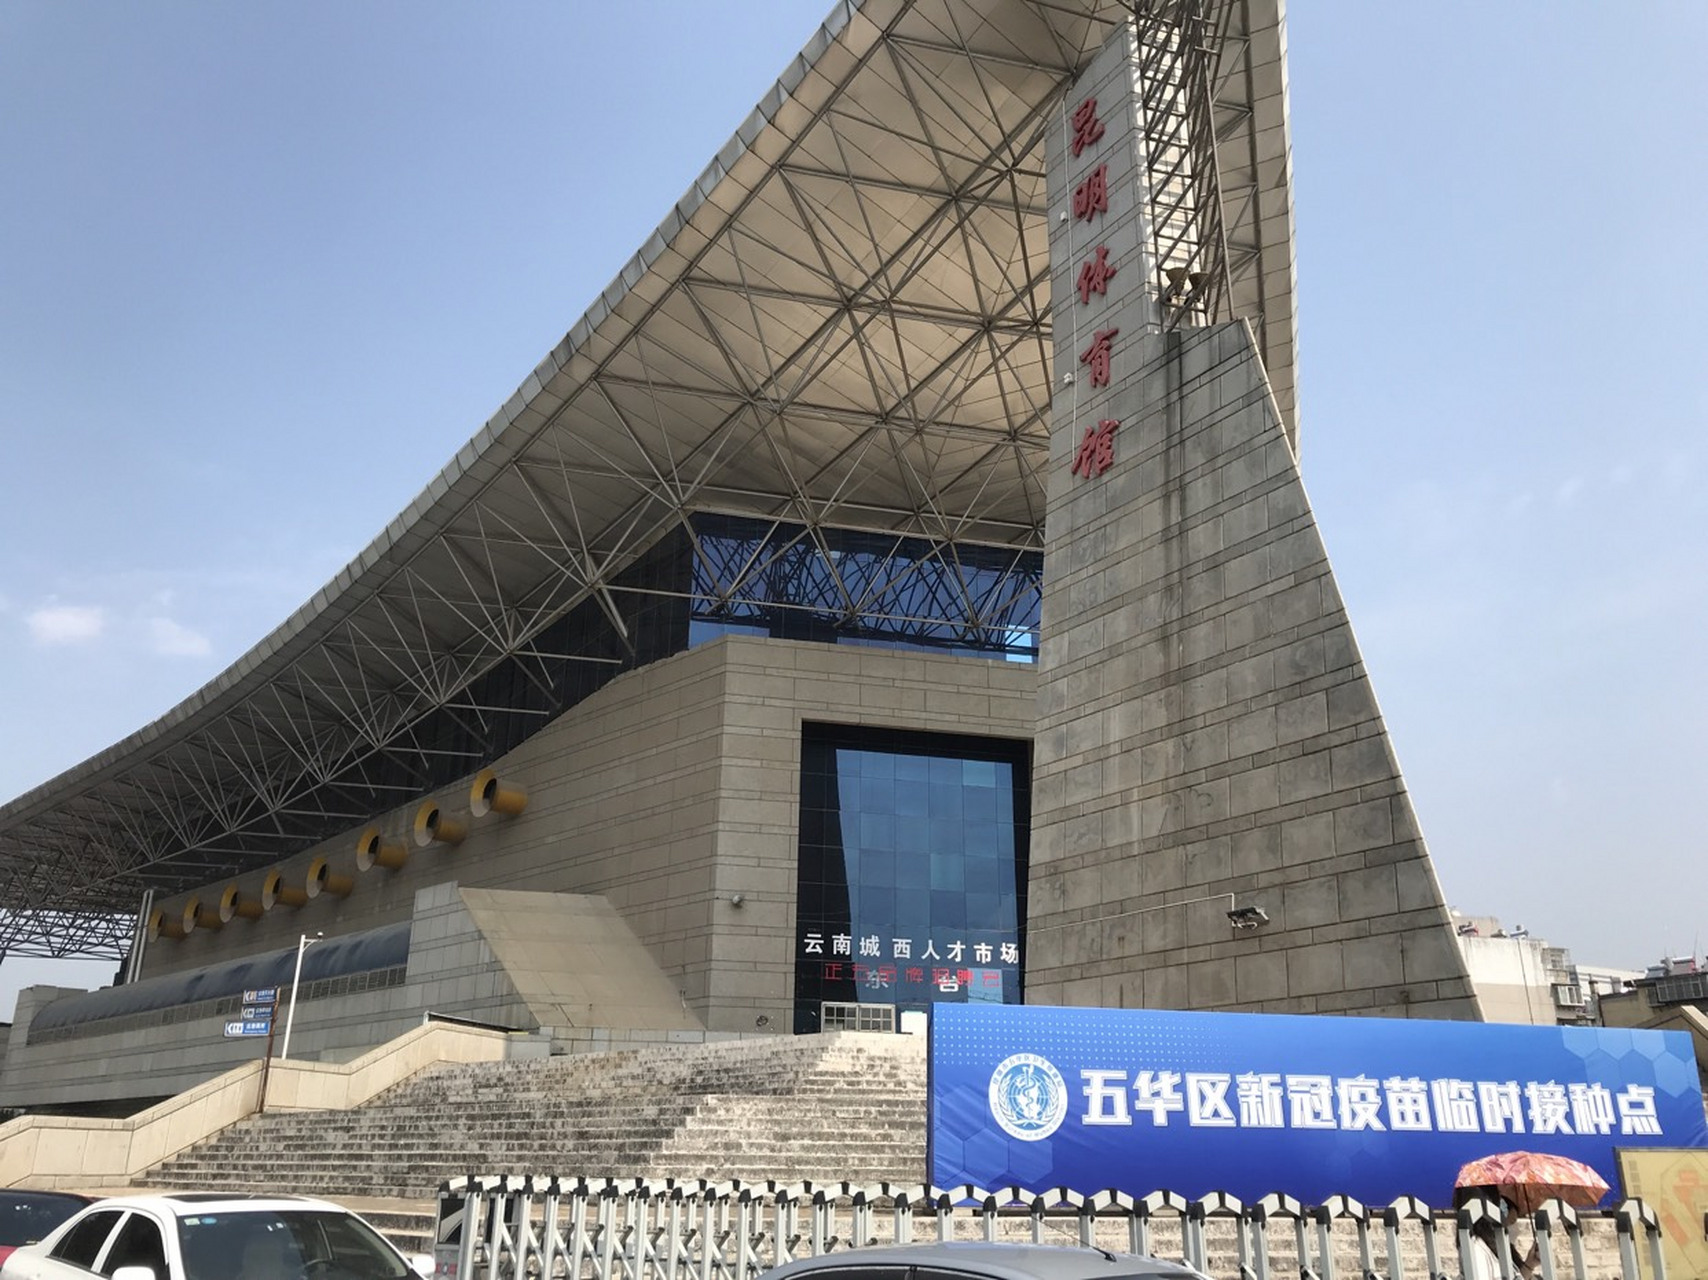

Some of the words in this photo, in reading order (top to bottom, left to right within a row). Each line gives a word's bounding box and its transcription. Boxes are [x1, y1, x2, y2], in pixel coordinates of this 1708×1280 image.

[1071, 97, 1120, 479] 昆明体育馆
[804, 933, 1019, 964] 云南城西人才市场
[1080, 1069, 1664, 1135] 五华区新冠疫苗临时接种点
